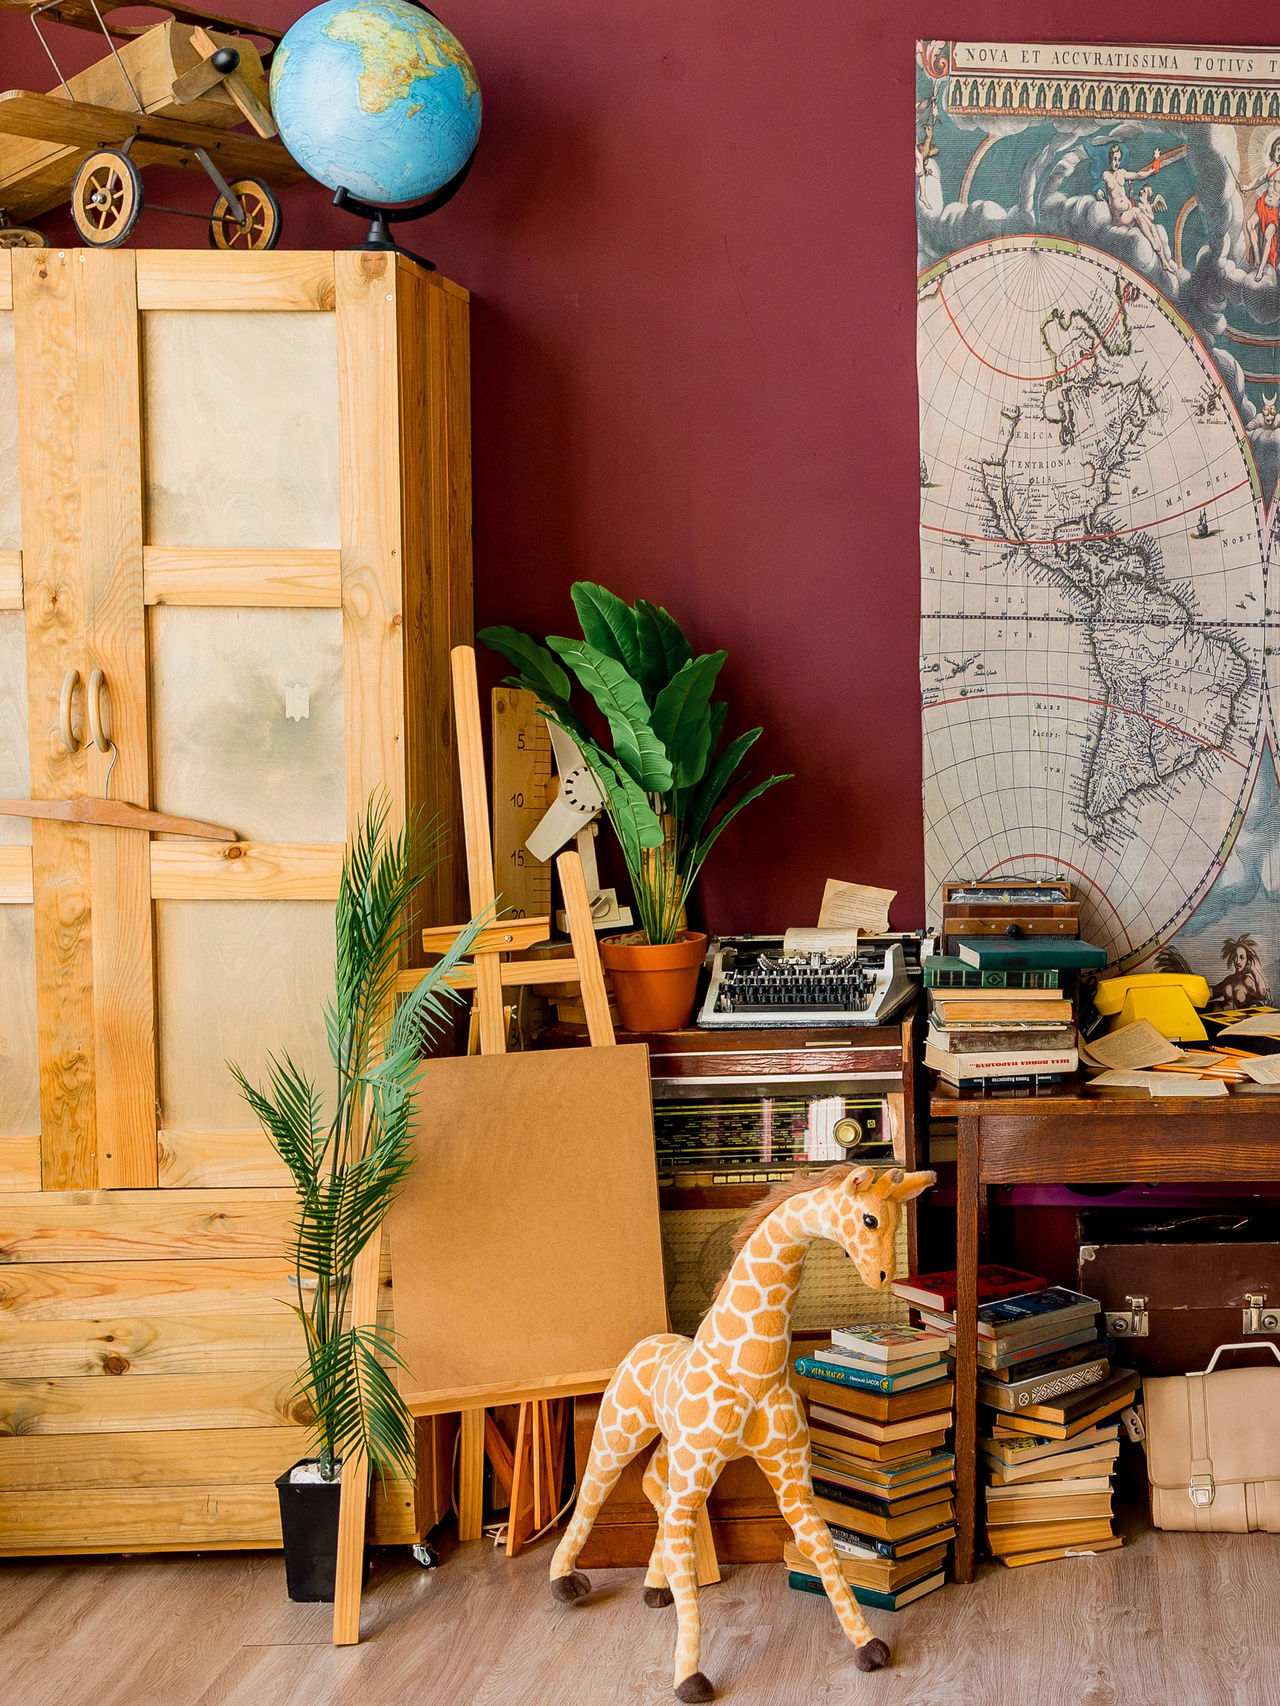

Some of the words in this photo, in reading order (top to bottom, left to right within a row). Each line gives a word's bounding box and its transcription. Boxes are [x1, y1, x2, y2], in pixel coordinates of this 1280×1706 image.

[966, 48, 1009, 63] NOVA
[1021, 49, 1041, 64] ET
[1051, 52, 1179, 70] ACCVRATISSIMA
[1193, 57, 1255, 73] TOTIVS
[517, 733, 526, 750] 5
[510, 793, 524, 808] 10
[510, 850, 525, 867] 15
[1020, 1059, 1049, 1067] ВОЙНА
[811, 1367, 825, 1376] ИГРА
[825, 1369, 845, 1380] МАГИЙ
[866, 1378, 880, 1387] БАСОВ
